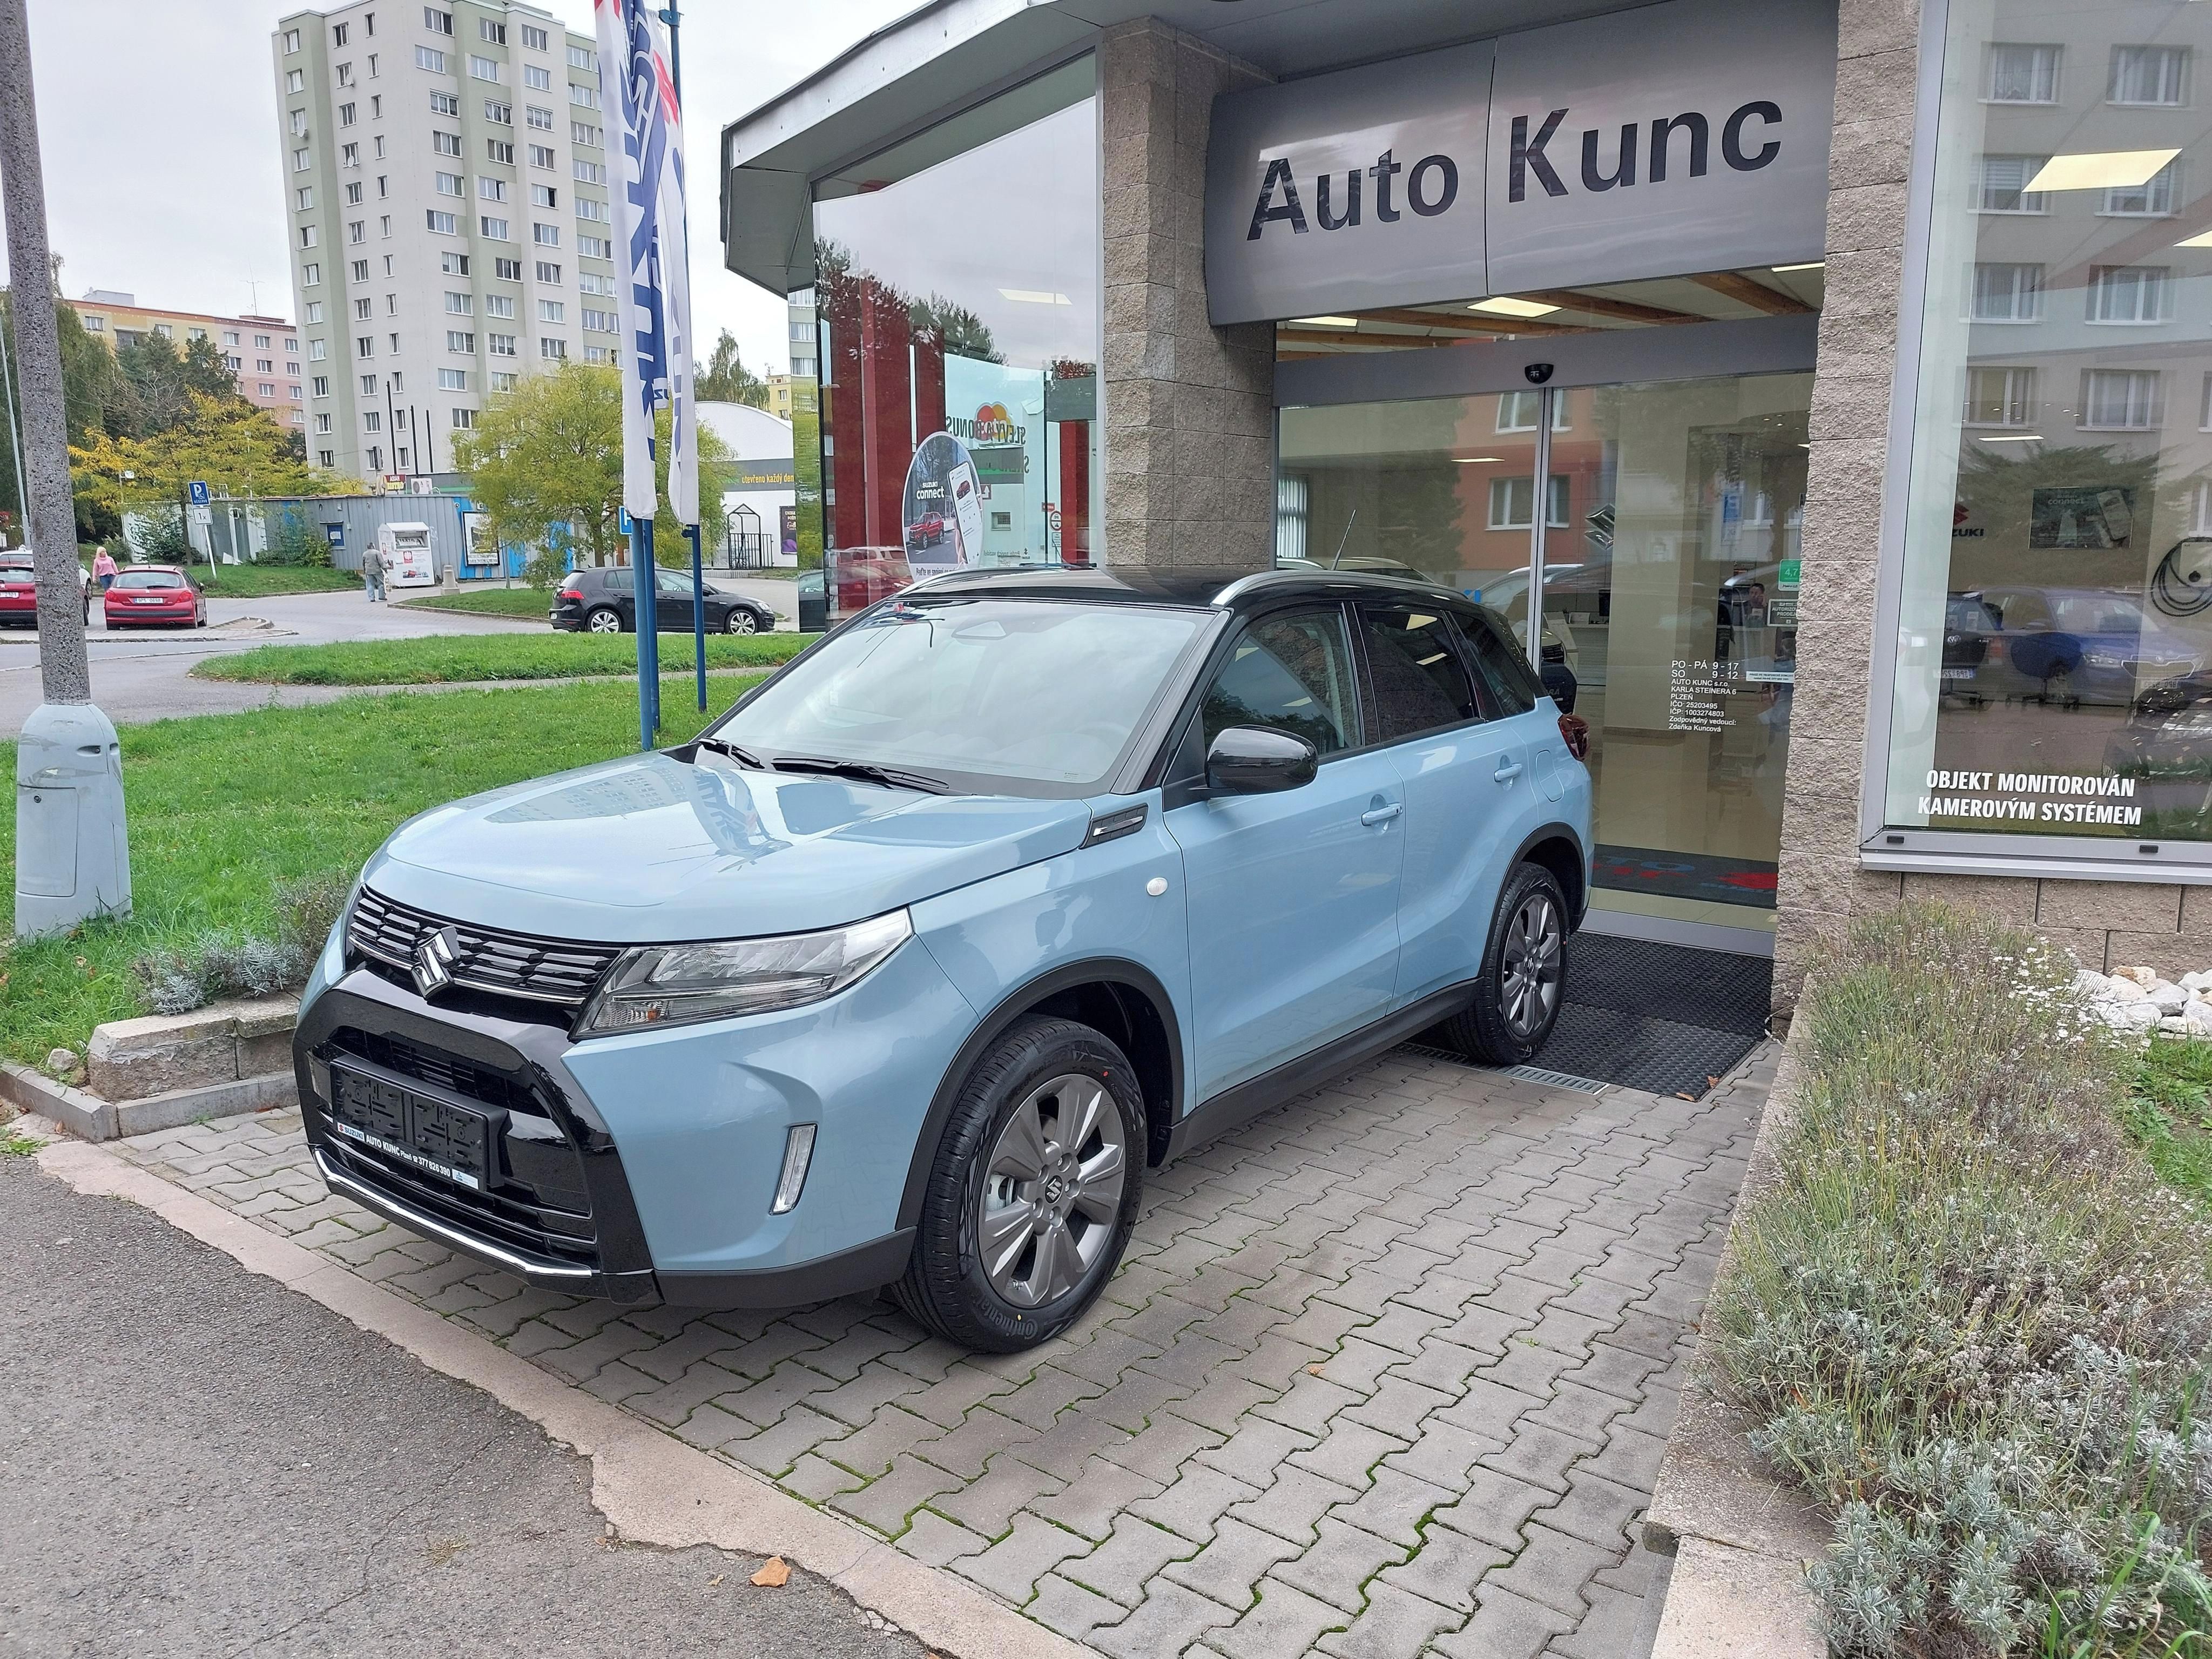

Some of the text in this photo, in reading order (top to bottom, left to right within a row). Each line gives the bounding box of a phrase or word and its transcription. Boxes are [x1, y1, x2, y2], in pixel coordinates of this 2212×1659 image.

[1246, 99, 1783, 242] Auto Kunc
[916, 487, 945, 500] connect
[1785, 568, 1798, 577] 4,7
[1694, 659, 1708, 669] PÁ
[1671, 670, 1685, 678] SO
[1728, 671, 1739, 679] 12
[1669, 716, 1708, 725] Zodpovědný
[1926, 770, 2135, 797] OBJEKT MONITOROVÁN
[1918, 797, 2142, 825] KAMEROVÝM SYSTÉMEM
[344, 1127, 364, 1139] SUZUKI
[366, 1134, 450, 1177] AUTO KUNC Plzeň 377 826 390
